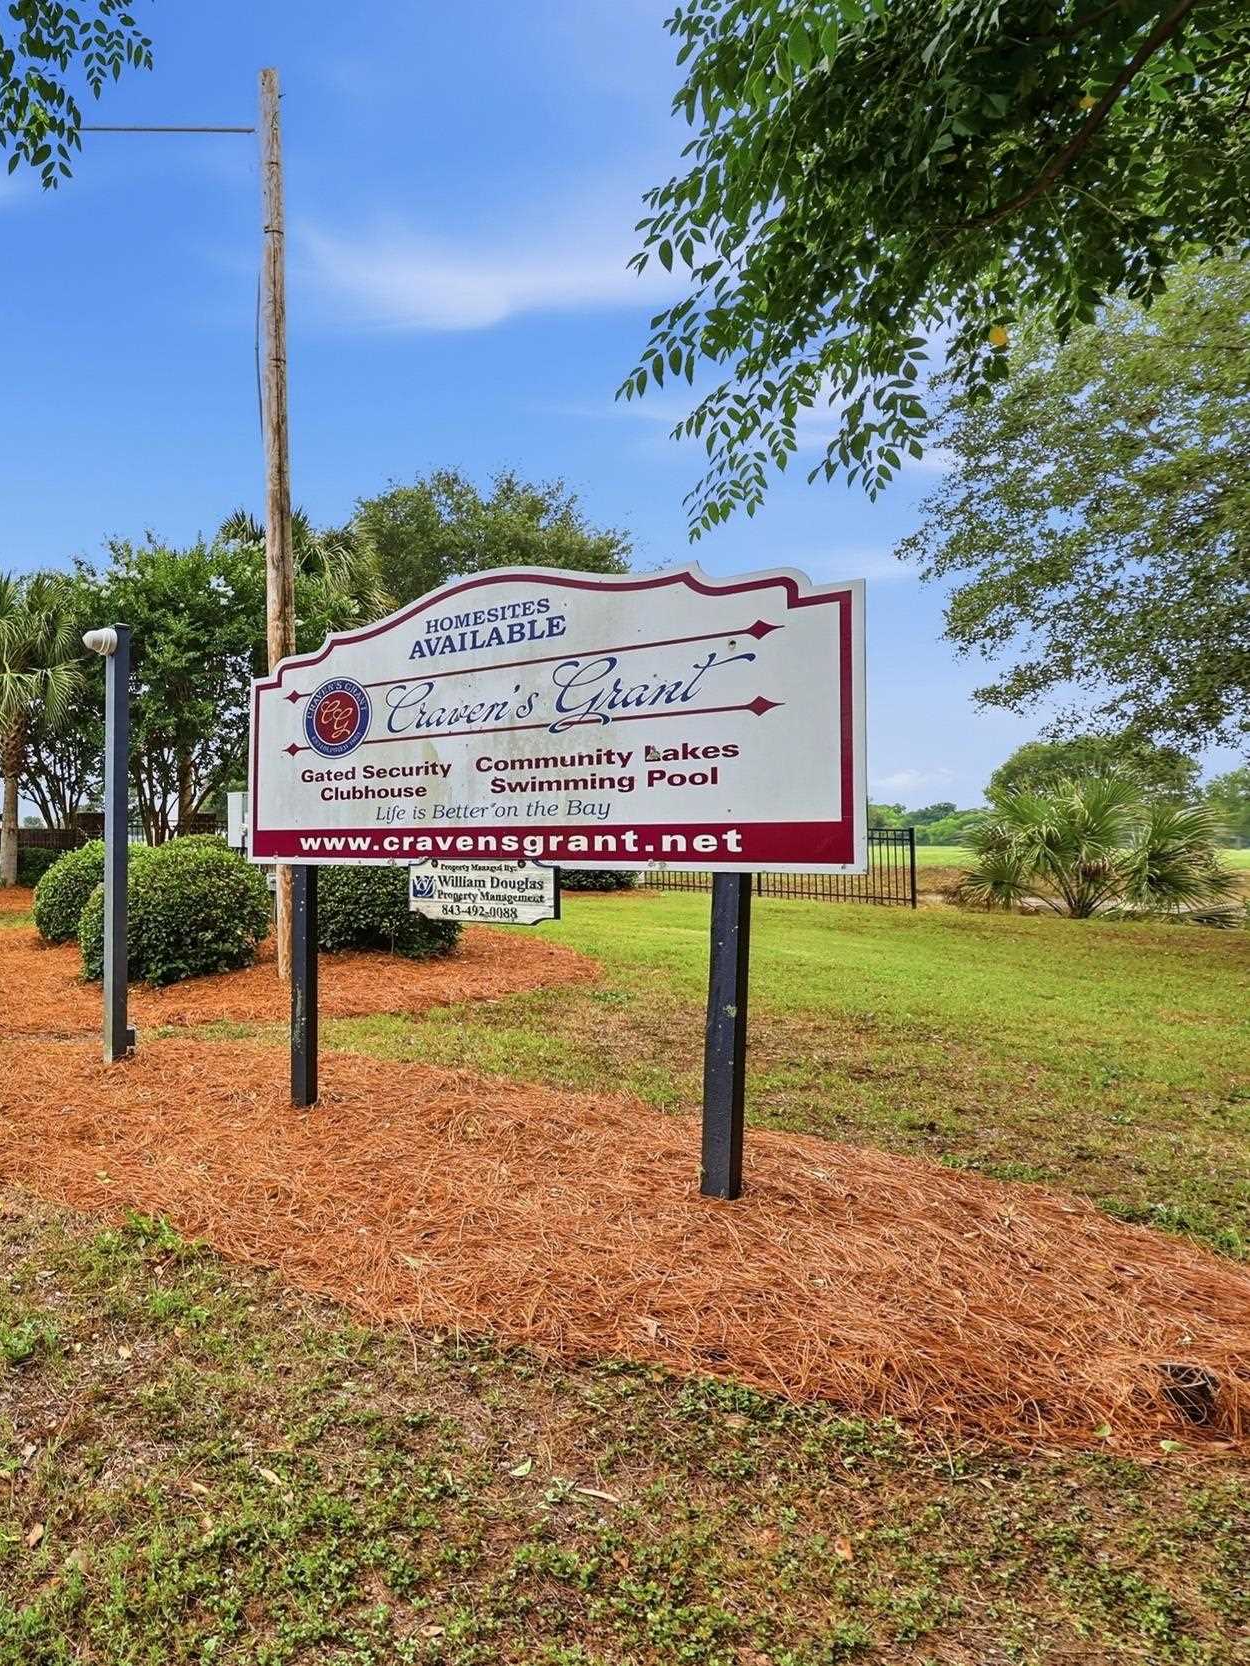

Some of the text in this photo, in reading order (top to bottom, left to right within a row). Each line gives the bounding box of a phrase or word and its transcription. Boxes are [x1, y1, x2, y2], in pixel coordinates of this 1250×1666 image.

[425, 598, 551, 634] HOMESITES
[409, 615, 567, 660] AVAILABLE
[386, 652, 756, 734] Craven's Grant
[475, 743, 740, 773] Community Lakes
[300, 761, 453, 784] Gated Security
[490, 767, 720, 794] Swimming Pool
[320, 783, 427, 801] Clubhouse
[375, 799, 611, 823] Life is Better on the Bay
[299, 829, 743, 857] www.cravensgrant.net
[438, 875, 544, 892] William Douglas
[437, 890, 545, 904] Property Management
[441, 905, 519, 919] 843-492-0088
